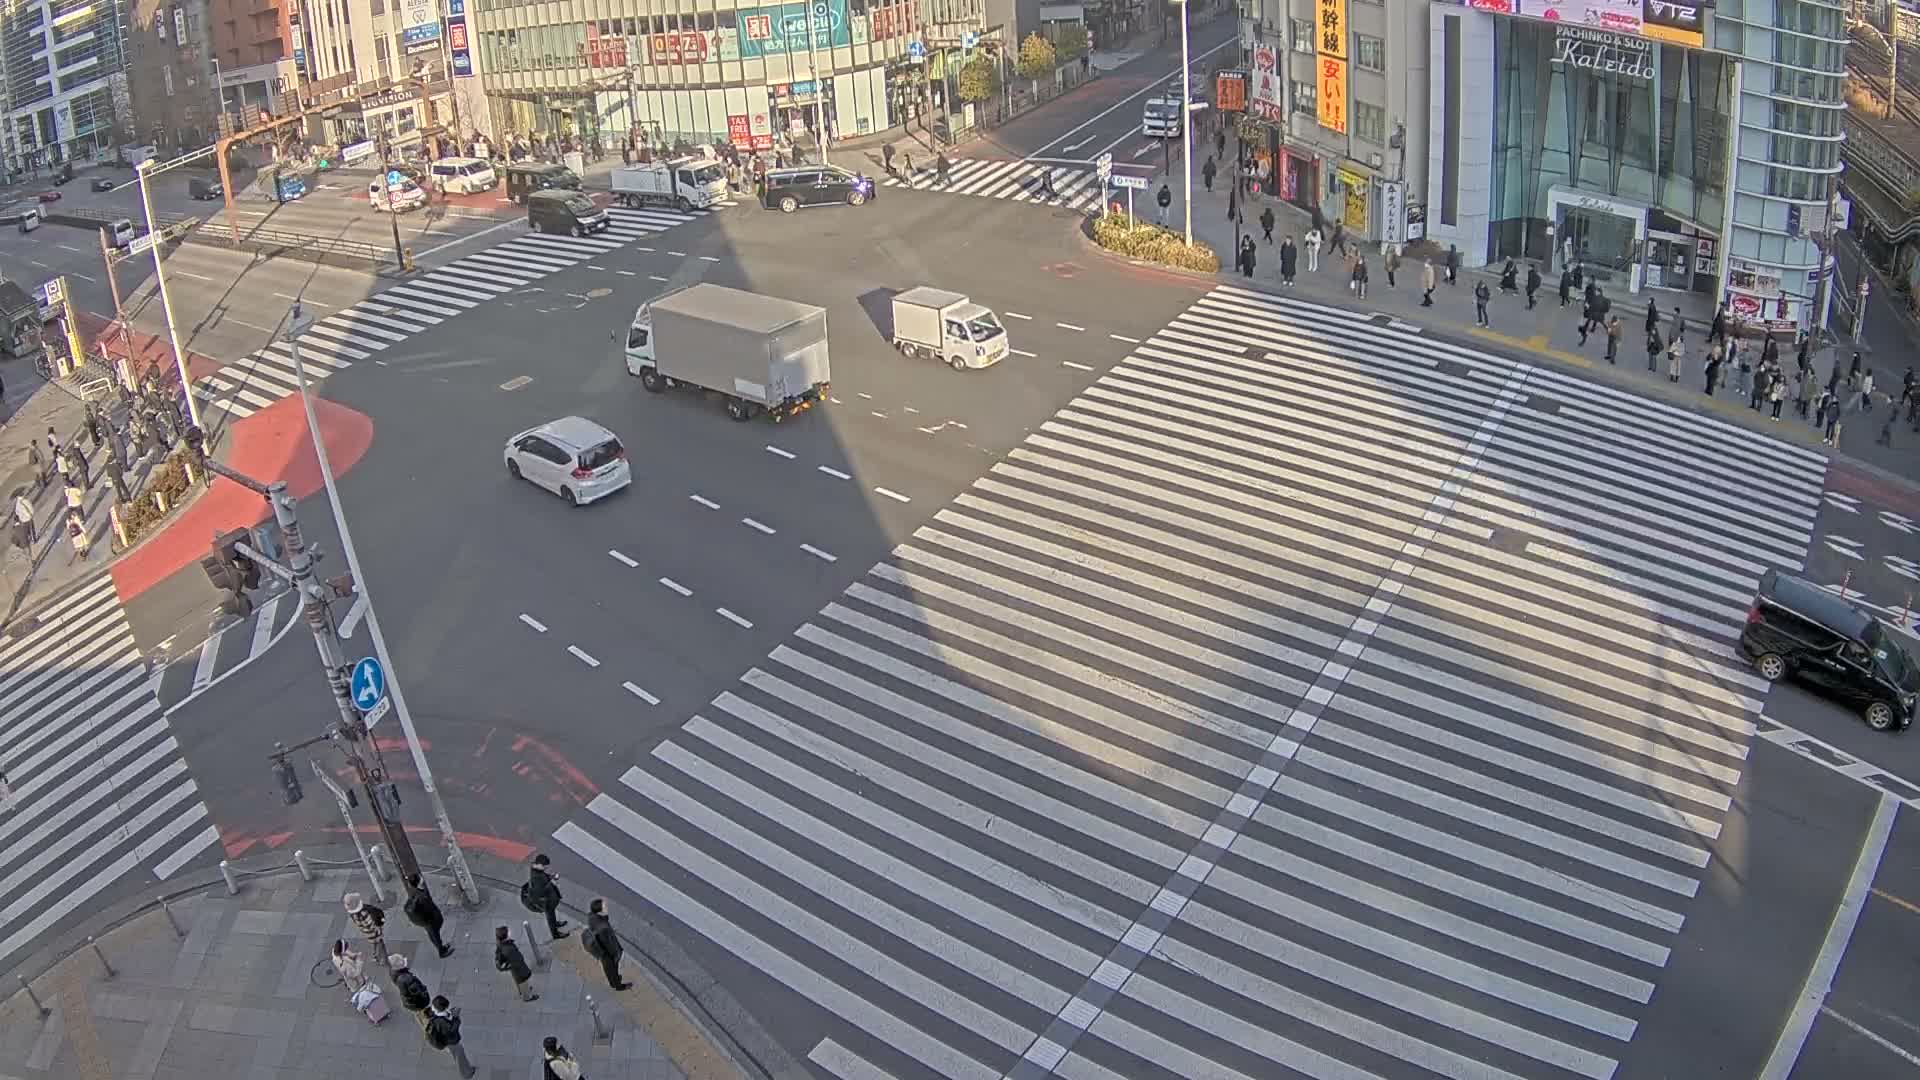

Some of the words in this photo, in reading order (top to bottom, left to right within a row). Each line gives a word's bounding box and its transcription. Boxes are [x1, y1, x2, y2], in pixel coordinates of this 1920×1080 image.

[1556, 26, 1611, 43] PACHINKO
[1624, 38, 1650, 51] SLOT
[1550, 38, 1656, 80] Kaleido
[730, 125, 749, 133] FREE
[731, 117, 746, 125] TAX
